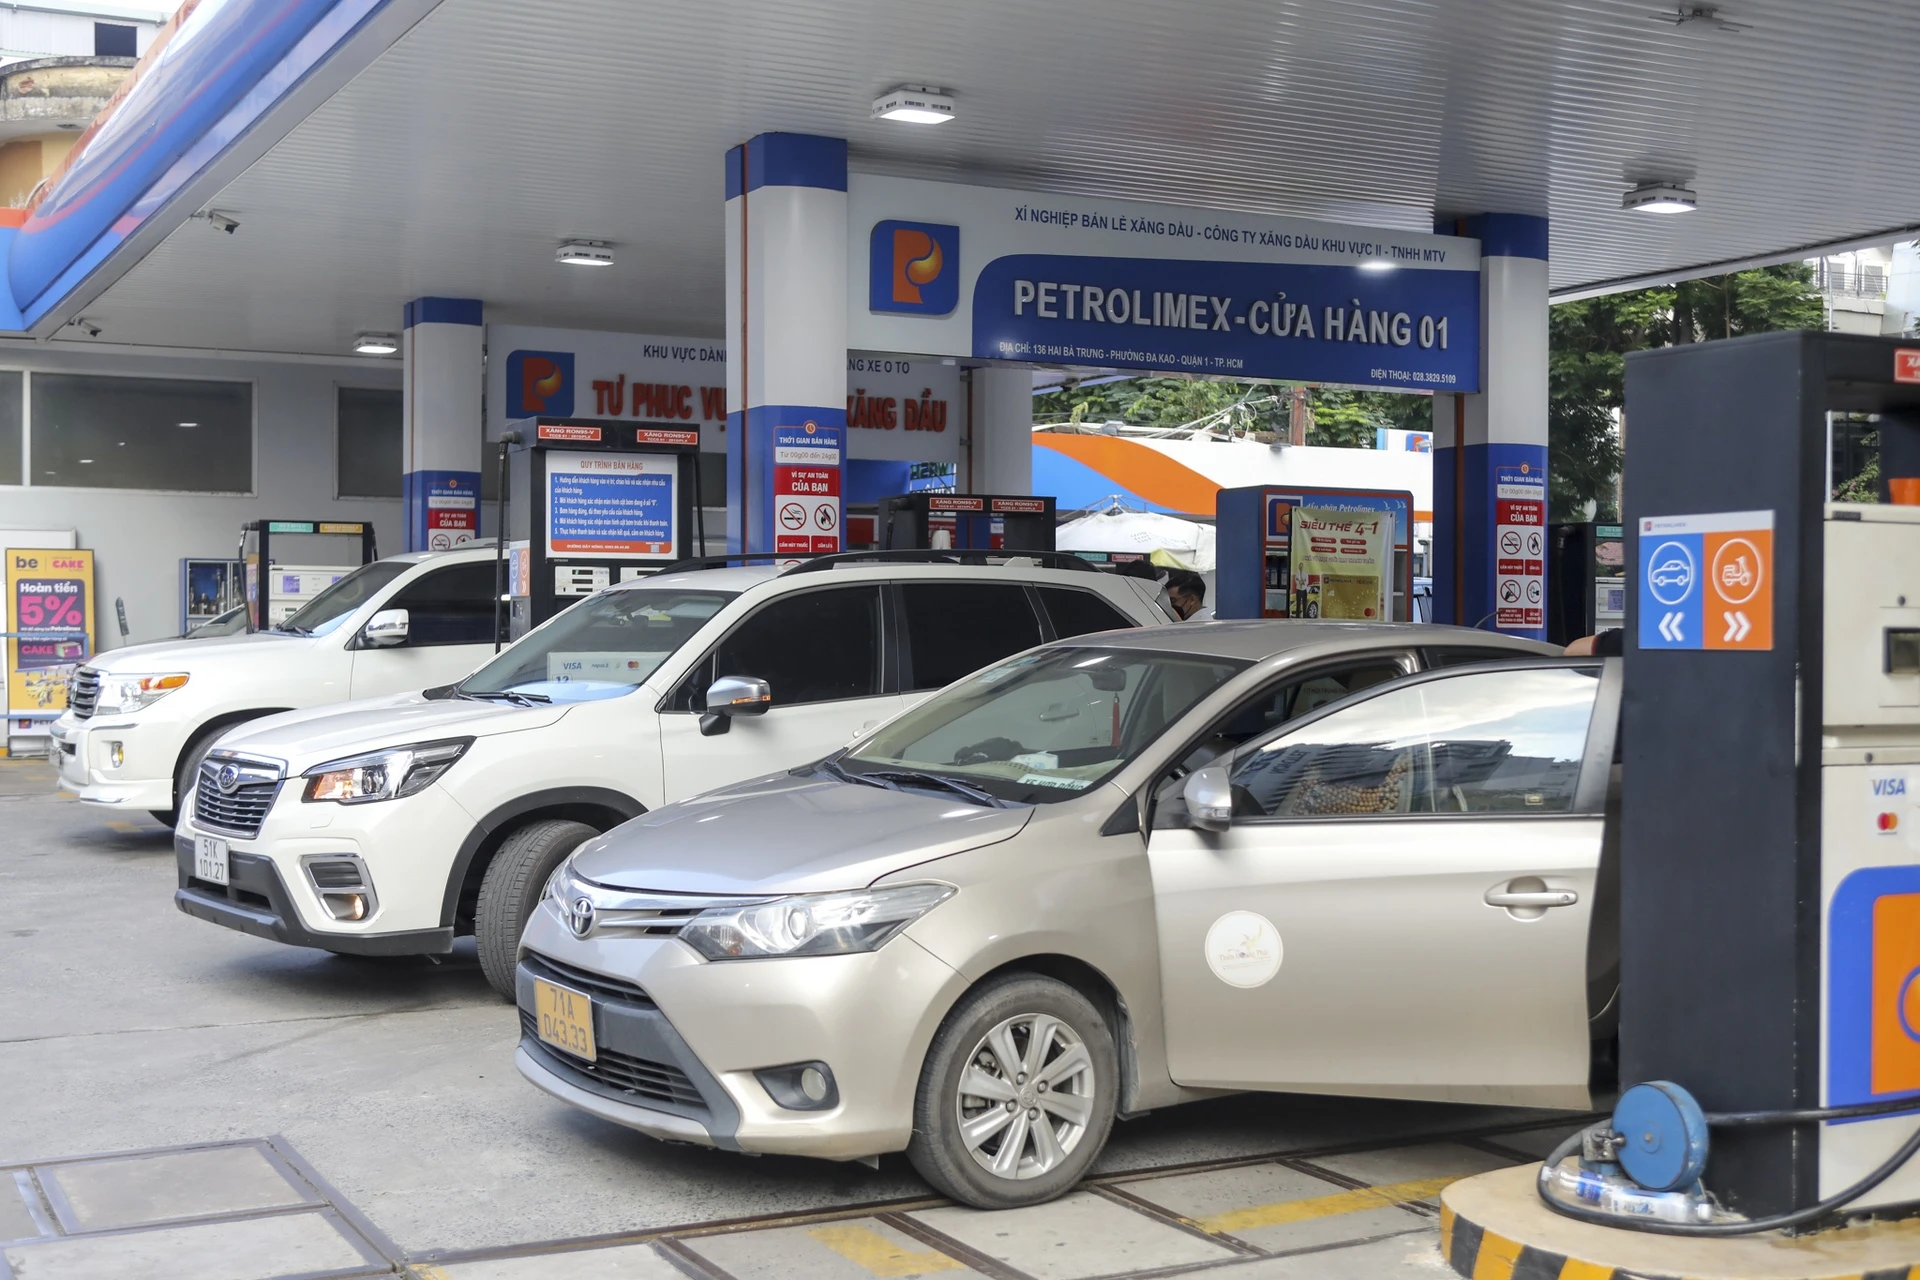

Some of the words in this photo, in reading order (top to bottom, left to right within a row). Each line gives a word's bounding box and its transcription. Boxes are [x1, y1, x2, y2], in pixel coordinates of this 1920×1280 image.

[1015, 205, 1027, 221] XÍ
[1031, 209, 1078, 228] NGHIỆP
[1082, 212, 1108, 230] BÁN
[1130, 217, 1165, 235] XĂNG
[1204, 225, 1239, 243] CÔNG
[1242, 230, 1256, 244] TY
[1259, 230, 1292, 248] XĂNG
[1322, 239, 1346, 253] KHU
[1349, 241, 1373, 258] VỰC
[1375, 245, 1382, 257] II
[1391, 246, 1420, 261] TNHH
[1424, 249, 1446, 263] MTV
[1324, 299, 1411, 347] HÀNG
[1419, 315, 1448, 349] 01
[643, 344, 668, 359] KHU
[671, 346, 696, 363] VỰC
[847, 358, 864, 371] NG
[867, 360, 881, 372] XE
[884, 361, 892, 373] O
[895, 361, 910, 374] TO
[1015, 341, 1031, 353] CHỈ:
[1033, 345, 1046, 355] 136
[1048, 345, 1061, 356] HAI
[1063, 344, 1074, 357] BÀ
[1076, 347, 1104, 359] TRƯNG
[1110, 349, 1145, 362] PHƯỜNG
[1146, 353, 1157, 363] ĐA
[1158, 353, 1175, 364] KAO
[1181, 355, 1202, 367] QUẬN
[1215, 357, 1225, 368] TP.
[1227, 358, 1243, 369] HCM
[1371, 369, 1387, 380] ĐIỆN
[1389, 370, 1411, 382] THOẠI:
[1413, 372, 1456, 383] 028.3829.5109
[796, 437, 810, 445] GIAN
[811, 436, 823, 446] BÁN
[580, 460, 593, 469] QUY
[594, 459, 612, 470] TRÌNH
[614, 461, 625, 470] BÁN
[627, 461, 643, 471] HÀNG
[791, 479, 810, 491] CỦA
[811, 482, 829, 494] BẠN
[1510, 512, 1524, 522] CỦA
[1526, 515, 1537, 524] BẠN
[1355, 523, 1364, 535] 4
[1370, 521, 1378, 535] 1
[16, 556, 38, 569] be
[52, 560, 84, 569] CAKE
[20, 582, 52, 593] Hoàn
[54, 581, 77, 593] tiền
[20, 595, 82, 625] 5%
[21, 645, 53, 655] CAKE
[563, 662, 582, 670] VISA
[1871, 778, 1906, 796] VISA
[203, 839, 218, 859] 51K
[200, 858, 225, 881] 101.27
[550, 987, 575, 1020] 71A
[543, 1013, 588, 1054] 043.33
